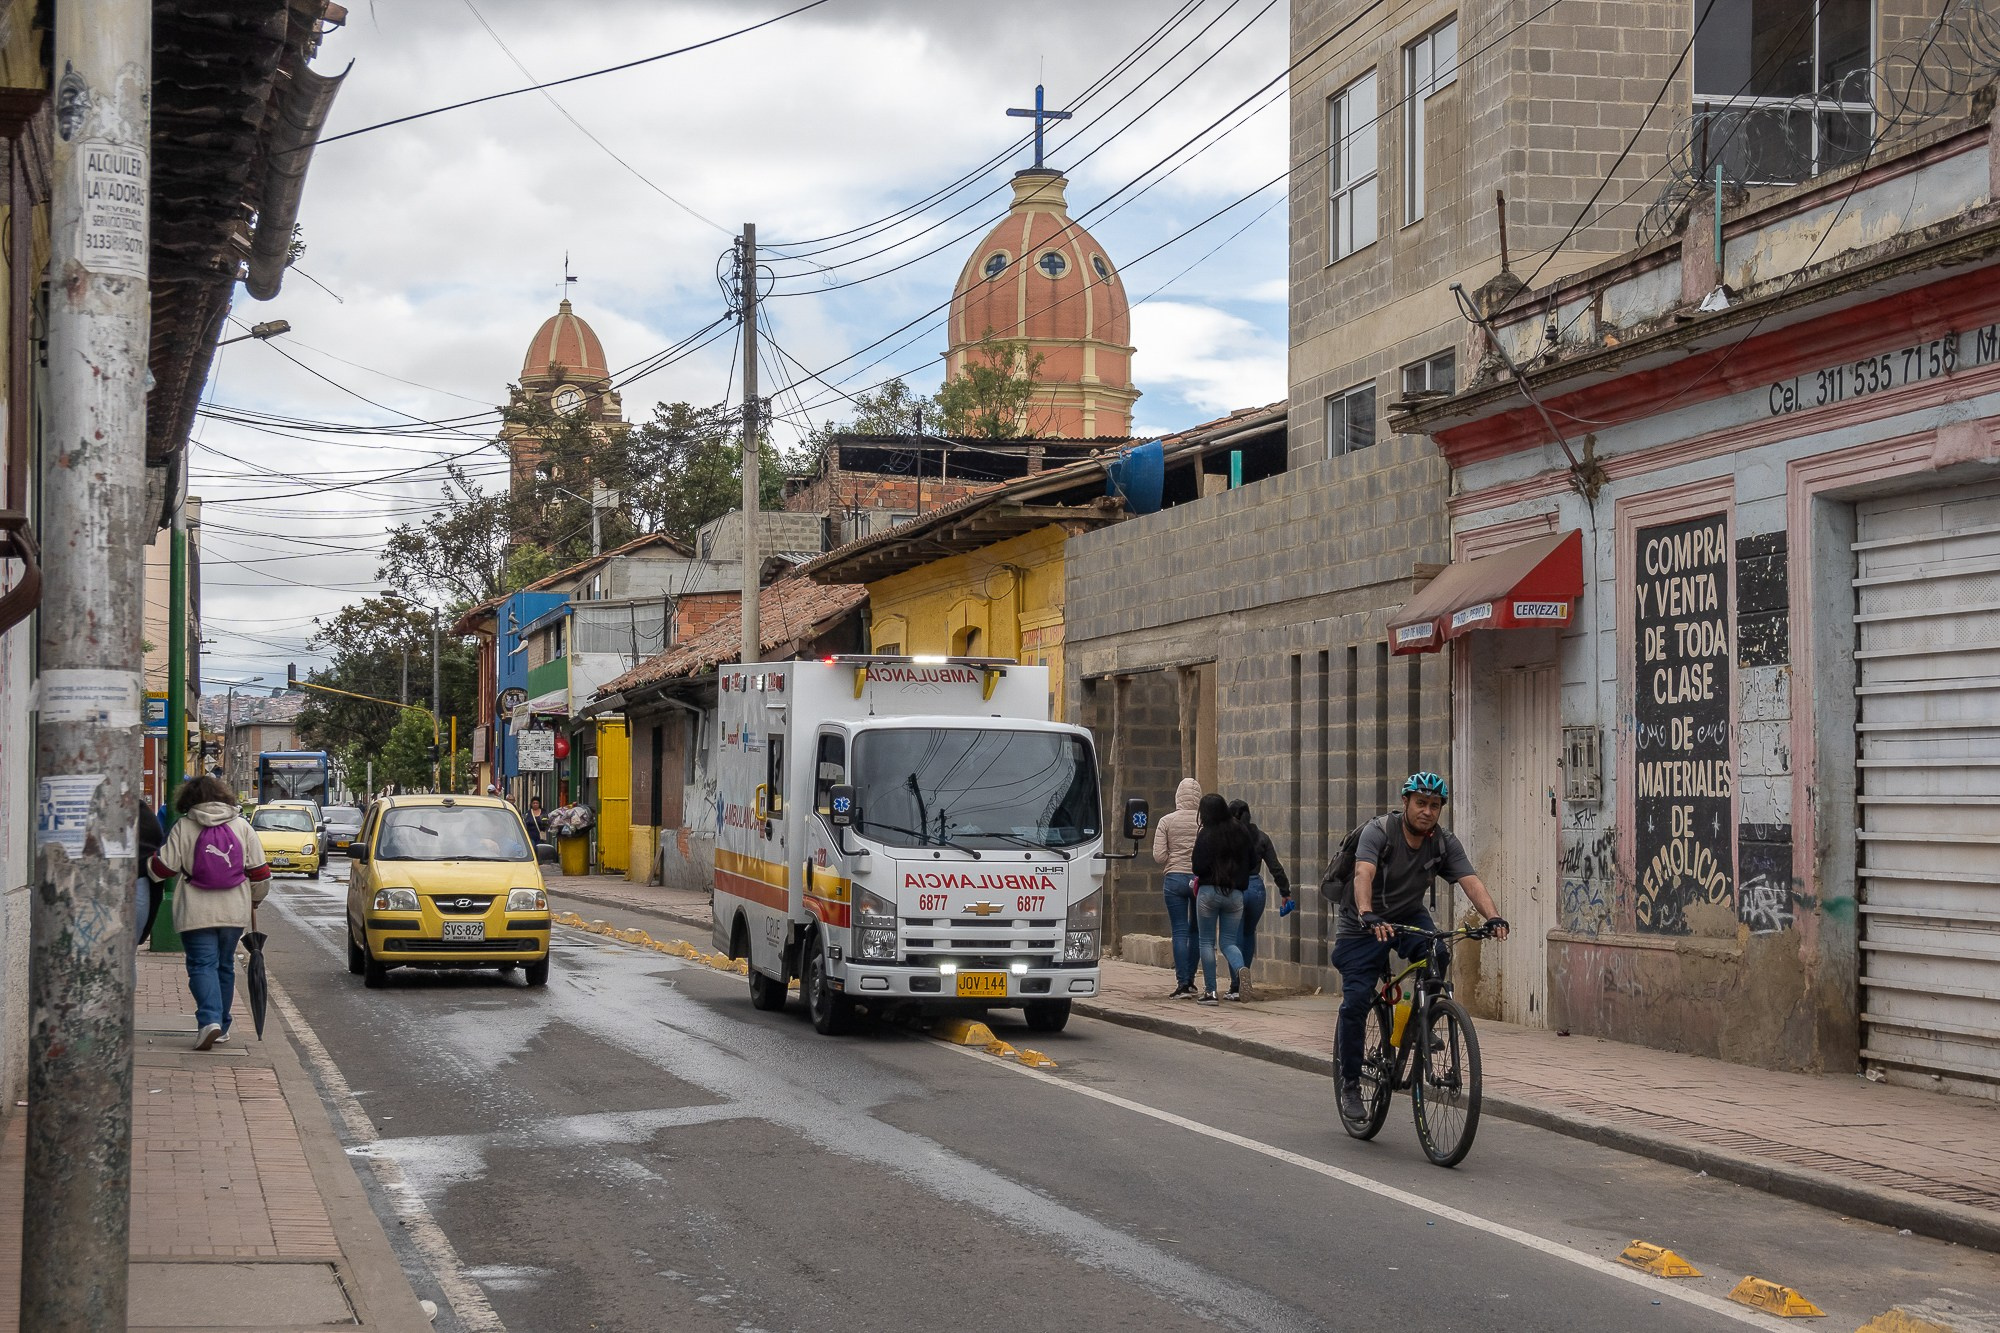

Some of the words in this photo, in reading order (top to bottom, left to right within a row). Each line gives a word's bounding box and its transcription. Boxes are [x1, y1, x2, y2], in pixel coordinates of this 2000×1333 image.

[88, 153, 143, 178] ALQUILER
[97, 204, 142, 216] NEVERAS
[1769, 376, 1802, 416] Cel.
[1816, 366, 1843, 406] 311
[1854, 353, 1892, 396] 535
[1645, 523, 1726, 575] COMPRA
[1516, 604, 1559, 616] CERVEZA
[1636, 583, 1649, 619] Y
[1655, 572, 1718, 617] VENTA
[1645, 625, 1667, 663] DE
[1674, 618, 1728, 657] TODA
[1653, 662, 1714, 704] CLASE
[1671, 716, 1694, 750] DE
[1638, 760, 1732, 798] MATERIALES
[724, 803, 760, 831] AMBULANCIA
[1671, 805, 1694, 838] DE
[919, 894, 948, 911] 6877
[1017, 895, 1045, 912] 6877
[984, 976, 1006, 990] 144
